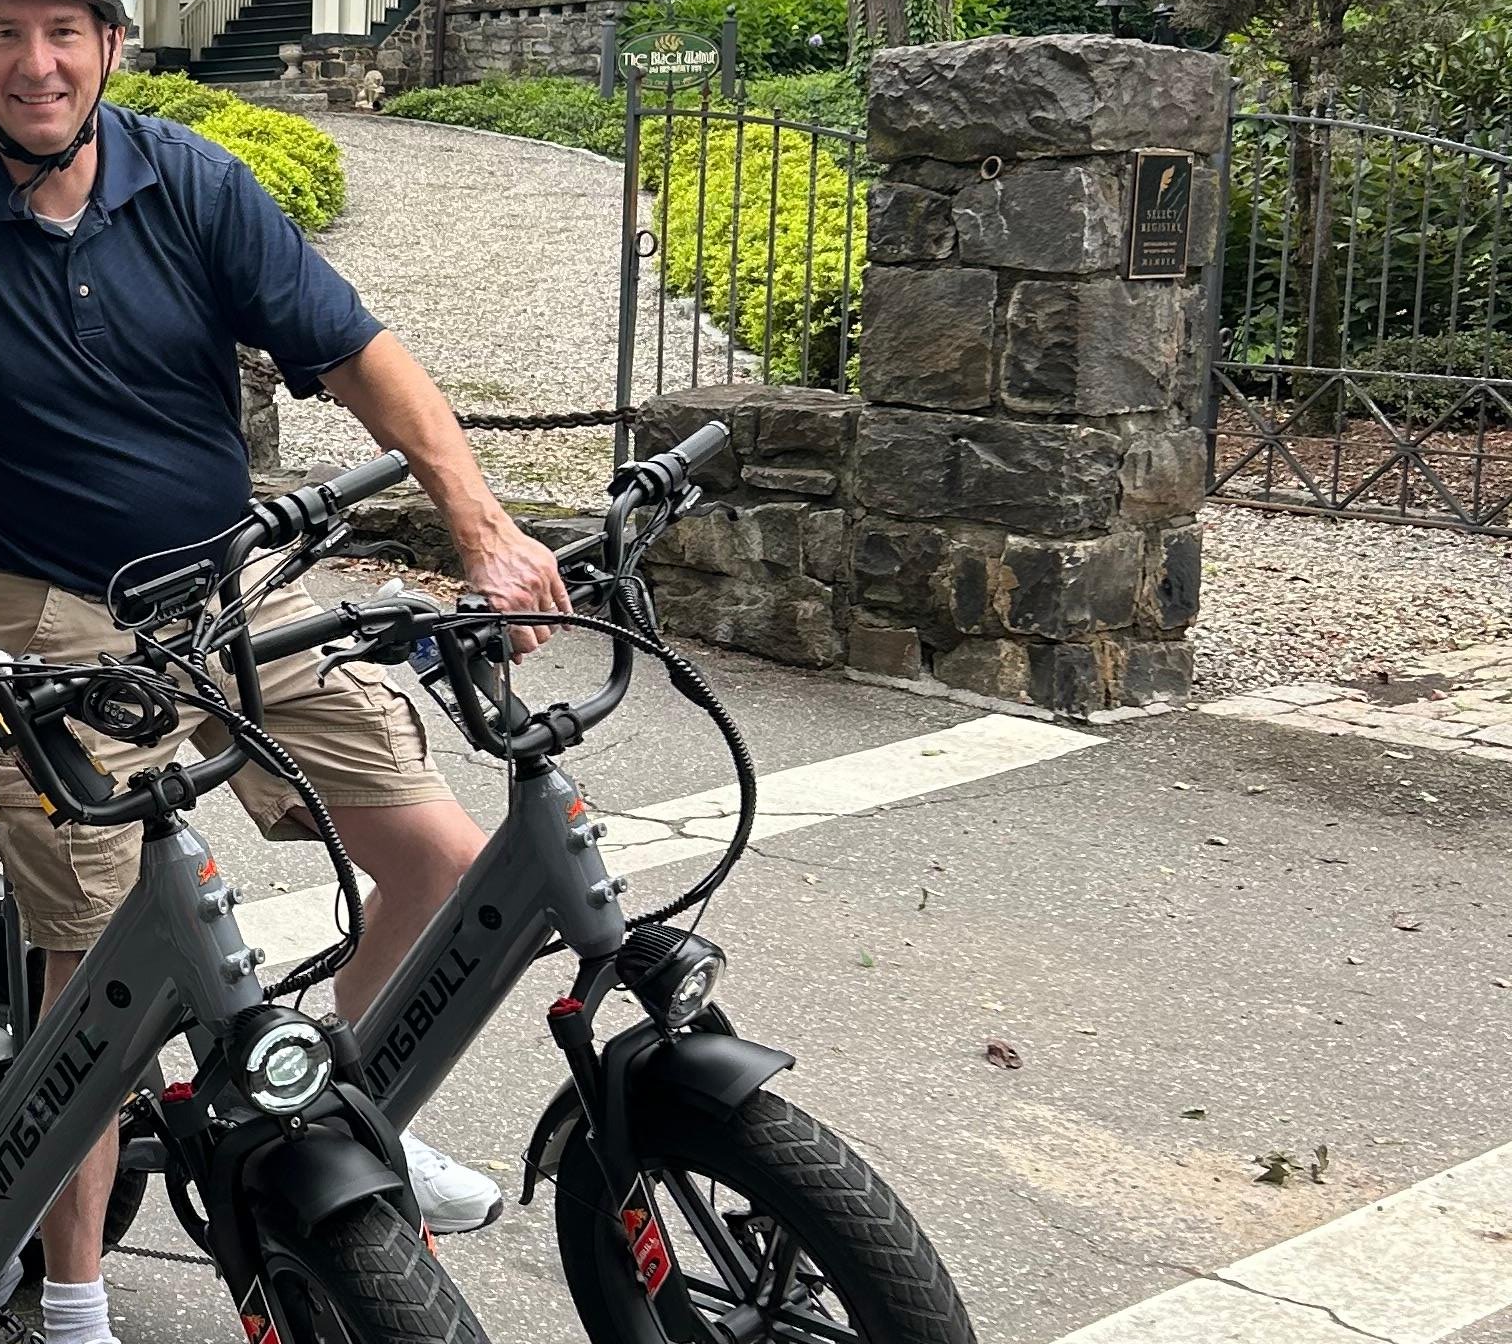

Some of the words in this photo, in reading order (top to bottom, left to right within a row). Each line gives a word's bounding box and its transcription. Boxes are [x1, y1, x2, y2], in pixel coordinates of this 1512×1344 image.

[1147, 209, 1177, 220] SELECT
[1141, 222, 1183, 234] REGISTRY
[364, 948, 481, 1100] INGBULL
